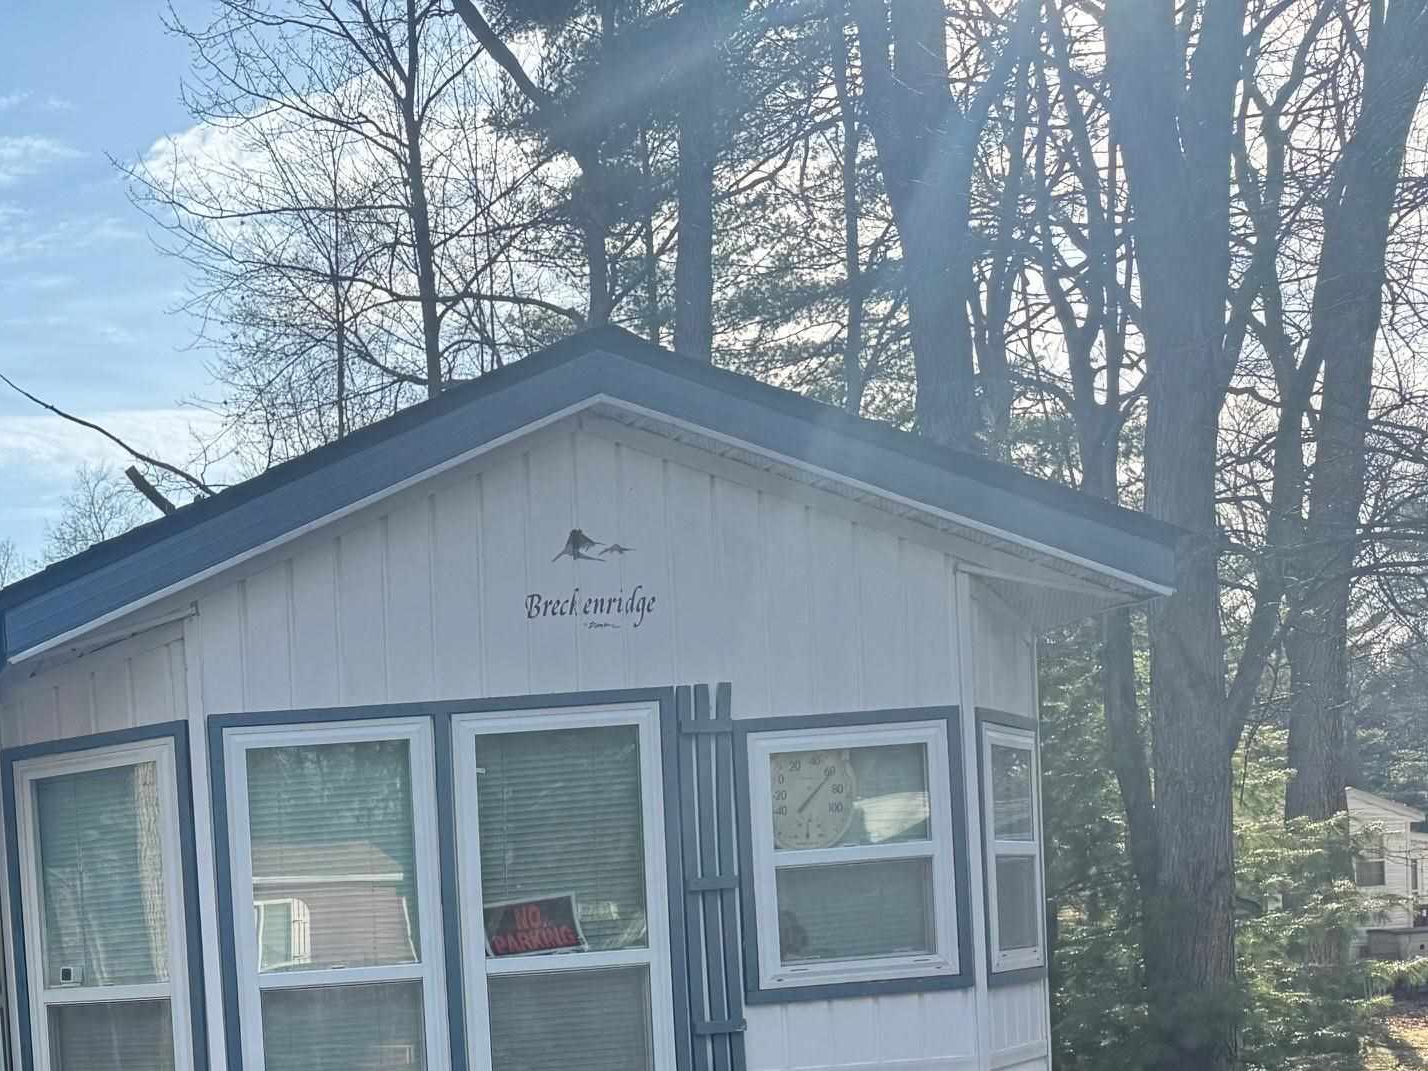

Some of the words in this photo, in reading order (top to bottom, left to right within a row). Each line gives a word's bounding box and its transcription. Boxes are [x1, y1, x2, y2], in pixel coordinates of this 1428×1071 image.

[525, 585, 656, 628] Breckenridge
[789, 760, 801, 771] 20
[514, 904, 541, 928] NO
[492, 927, 577, 955] PARKING
